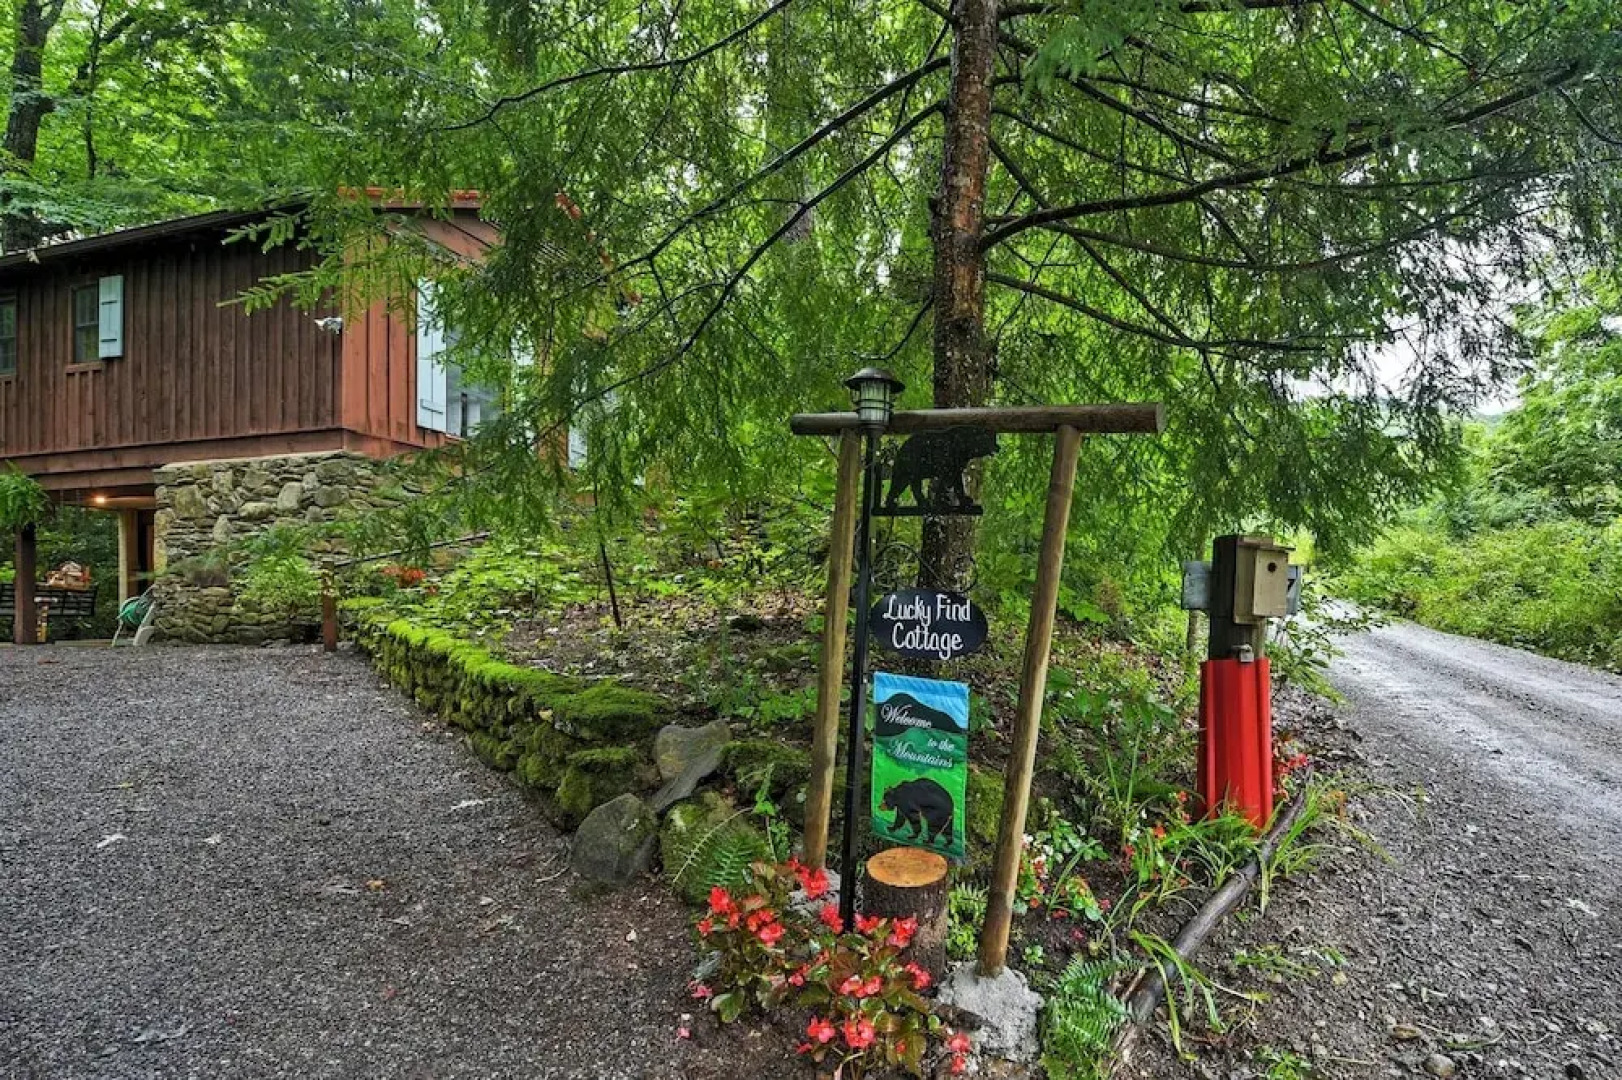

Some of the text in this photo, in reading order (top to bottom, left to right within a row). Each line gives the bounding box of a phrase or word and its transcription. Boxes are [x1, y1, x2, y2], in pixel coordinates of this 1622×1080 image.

[882, 593, 971, 627] Lucky Find
[891, 622, 964, 660] Cottage
[881, 703, 932, 729] Welcome
[886, 738, 953, 768] Mountains
[927, 737, 955, 753] to the
